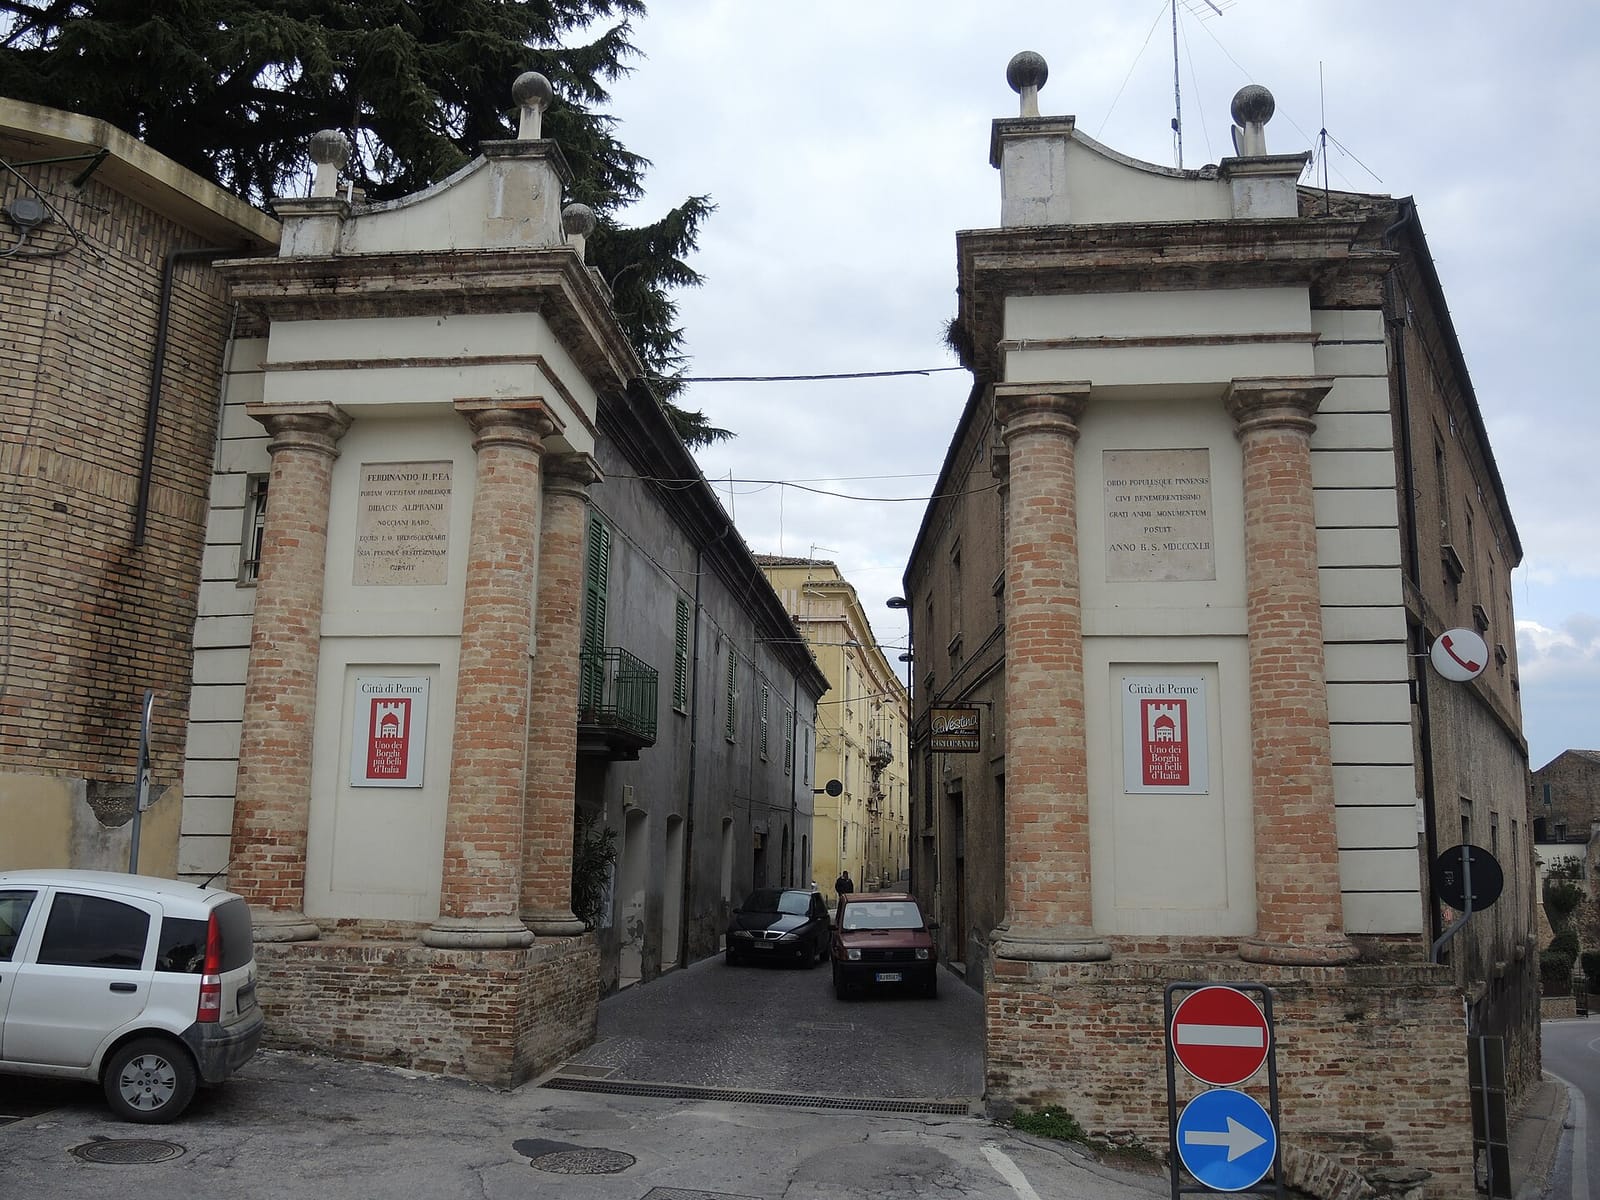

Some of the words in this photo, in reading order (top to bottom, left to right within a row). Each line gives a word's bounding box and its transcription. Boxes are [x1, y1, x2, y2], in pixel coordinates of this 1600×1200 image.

[367, 473, 418, 482] FERDINANDO
[1106, 479, 1127, 487] ORDO
[1143, 526, 1172, 534] POSUIT
[1109, 543, 1136, 552] ANNO
[361, 683, 383, 694] Città
[385, 683, 394, 694] di
[396, 683, 423, 694] Penne
[1128, 683, 1153, 694] Città
[1155, 683, 1165, 694] di
[1167, 683, 1199, 694] Penne
[375, 741, 390, 749] Uno
[391, 741, 403, 749] dei
[1149, 745, 1167, 753] Uno
[1168, 745, 1181, 754] dei
[376, 749, 400, 759] Borghi
[1151, 753, 1180, 763] Borghi
[1149, 763, 1163, 773] più
[1164, 762, 1182, 771] belli
[1151, 771, 1180, 780] d'Italia
